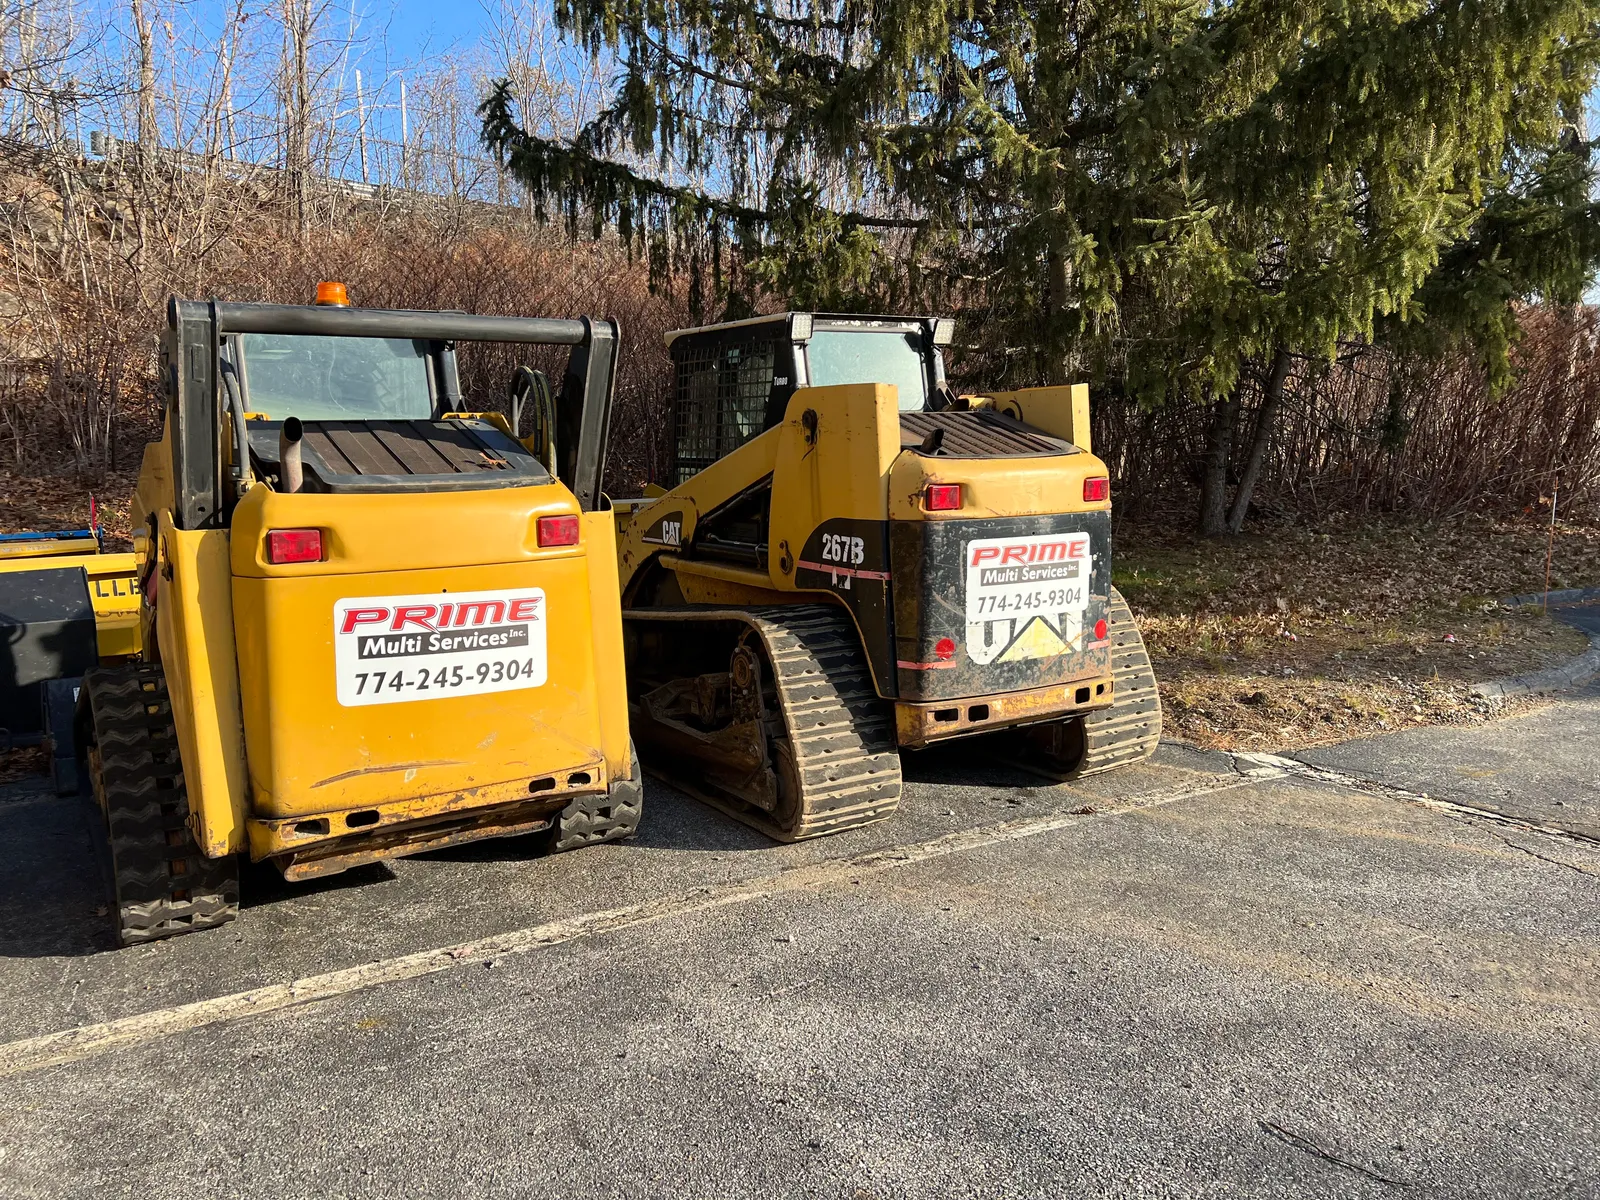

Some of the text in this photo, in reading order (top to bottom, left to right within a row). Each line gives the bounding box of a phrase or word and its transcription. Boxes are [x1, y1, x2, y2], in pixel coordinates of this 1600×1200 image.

[662, 520, 681, 546] CAT
[822, 532, 865, 565] 267B
[970, 539, 1089, 568] PRIME
[983, 568, 1019, 584] Multi
[1021, 565, 1068, 581] Services
[977, 587, 1081, 614] 774-245-9304
[340, 596, 543, 635] PRIME
[362, 628, 527, 656] Multi Services Inc.
[355, 657, 534, 696] 774-245-9304
